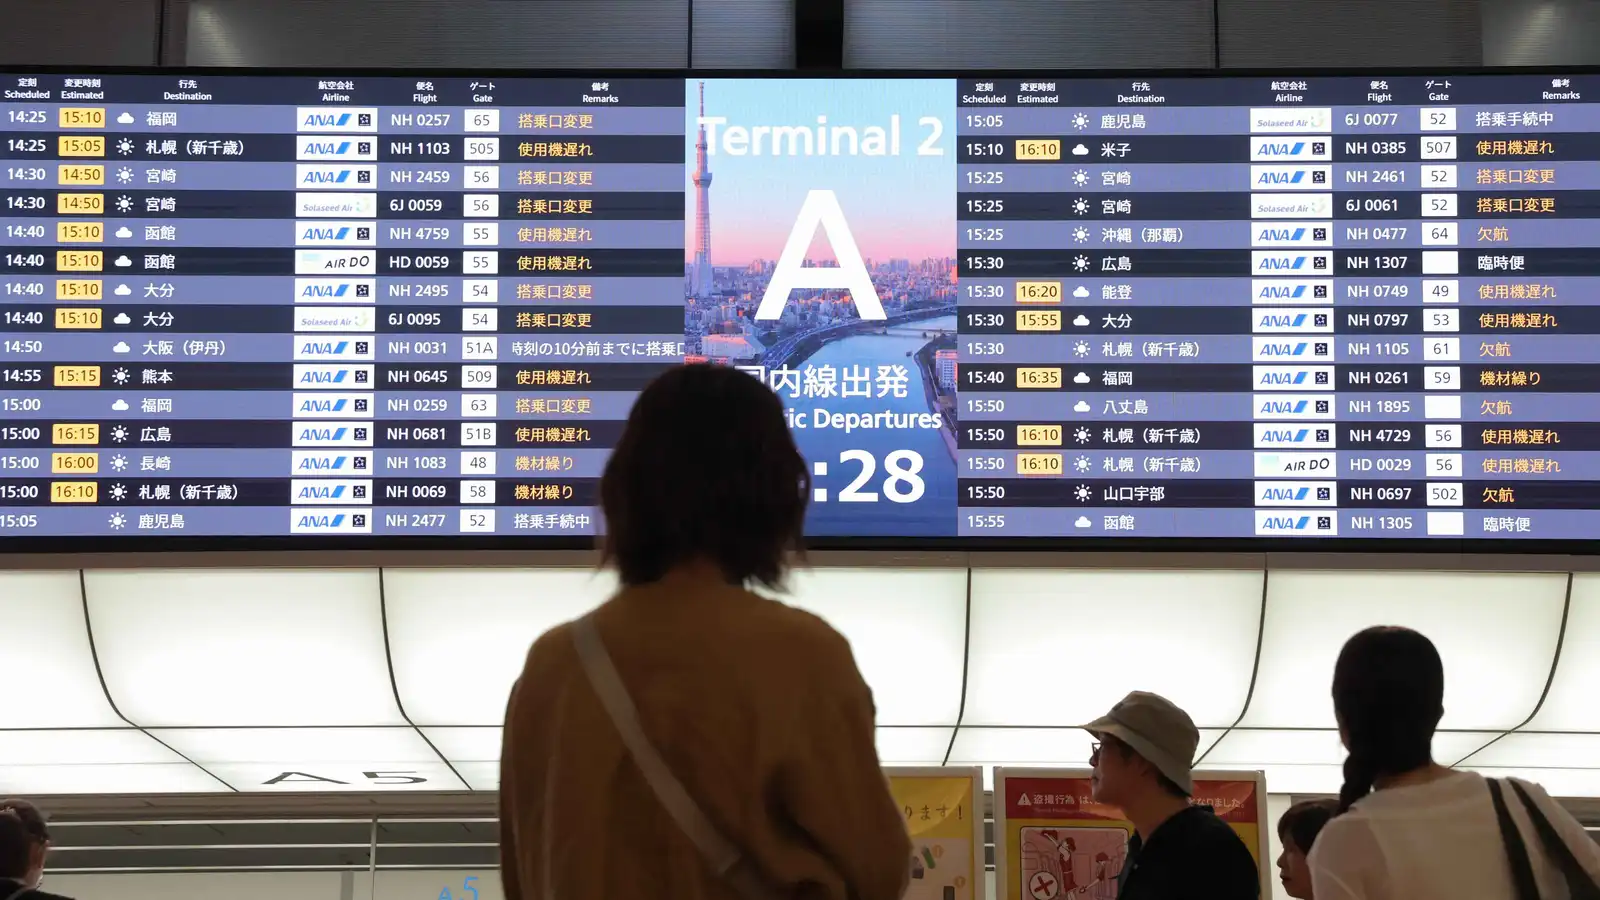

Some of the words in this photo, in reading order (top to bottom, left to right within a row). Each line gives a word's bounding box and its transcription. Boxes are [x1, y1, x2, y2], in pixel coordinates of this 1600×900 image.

[17, 77, 37, 88] 定刻
[64, 78, 101, 88] 変更時刻
[179, 80, 197, 88] 行先
[319, 81, 354, 90] 航空会社
[416, 82, 433, 90] 便名
[470, 82, 495, 90] ゲート
[592, 82, 609, 92] 備考
[976, 82, 993, 91] 定刻
[1020, 82, 1056, 92] 変更時刻
[1132, 82, 1150, 91] 行先
[1271, 81, 1307, 90] 航空会社
[1370, 81, 1388, 89] 便名
[1426, 80, 1451, 89] ゲート
[1552, 79, 1569, 87] 備考
[5, 90, 50, 98] Scheduled
[61, 91, 103, 99] Estimated
[164, 92, 212, 100] Destination
[322, 93, 349, 101] Airline
[414, 94, 437, 103] Flight
[473, 94, 492, 102] Gate
[963, 95, 1006, 103] Scheduled
[1018, 95, 1058, 103] Estimated
[1368, 93, 1391, 103] Flight
[1543, 91, 1580, 99] Remarks
[9, 111, 46, 122] 14:25
[65, 112, 101, 123] 15:10
[146, 112, 177, 126] 福岡
[304, 115, 334, 126] ANA
[392, 114, 412, 125] NH
[417, 114, 450, 126] 0257
[474, 115, 489, 126] 65
[518, 114, 592, 128] 搭乗口変更
[697, 115, 899, 156] Terminal
[918, 117, 944, 156] 2
[8, 140, 46, 151] 14:25
[64, 140, 100, 151] 15:05
[146, 140, 243, 155] 札幌（新千歳）
[304, 143, 334, 154] ANA
[391, 143, 411, 154] NH
[418, 143, 449, 154] 1103
[471, 143, 493, 154] 505
[518, 143, 593, 156] 使用機遅れ
[967, 144, 1003, 155] 15:10
[1021, 144, 1056, 155] 16:10
[1101, 143, 1131, 157] 米子
[1258, 144, 1288, 155] ANA
[1346, 142, 1367, 154] NH
[1372, 142, 1406, 154] 0385
[1427, 142, 1450, 153] 507
[1476, 140, 1554, 155] 使用機遅れ
[7, 197, 45, 208] 14:30
[64, 198, 100, 208] 14:50
[146, 197, 176, 211] 宮崎
[390, 199, 403, 211] 6J
[408, 199, 442, 211] 0059
[474, 200, 489, 211] 56
[518, 199, 592, 213] 搭乗口変更
[967, 229, 1003, 240] 15:25
[1102, 228, 1184, 242] 沖縄（那覇）
[1259, 230, 1289, 240] ANA
[1347, 228, 1368, 239] NH
[1373, 228, 1406, 239] 0477
[1432, 228, 1448, 239] 64
[1478, 227, 1508, 241] 欠航
[6, 254, 44, 266] 14:40
[754, 189, 887, 320] A
[63, 255, 98, 266] 15:10
[145, 253, 175, 272] 函館
[325, 259, 345, 268] AIR
[350, 256, 369, 267] DO
[390, 256, 411, 268] HD
[415, 256, 449, 268] 0059
[474, 257, 488, 268] 55
[517, 256, 592, 270] 使用機遅れ
[967, 286, 1003, 297] 15:30
[1021, 286, 1057, 297] 16:20
[1102, 285, 1132, 299] 能登
[1259, 287, 1290, 298] ANA
[1348, 286, 1368, 297] NH
[1374, 285, 1408, 297] 0749
[1432, 286, 1448, 296] 49
[1478, 285, 1556, 299] 使用機遅れ
[4, 341, 42, 352] 14:50
[143, 340, 225, 355] 大阪（伊丹）
[301, 343, 331, 354] ANA
[389, 342, 409, 353] NH
[414, 342, 446, 353] 0031
[467, 342, 493, 353] 51A
[3, 370, 41, 381] 14:55
[60, 370, 96, 381] 15:15
[142, 369, 172, 383] 熊本
[301, 372, 331, 382] ANA
[388, 371, 409, 382] NH
[414, 371, 447, 382] 0645
[468, 371, 491, 382] 509
[516, 370, 591, 384] 使用機遅れ
[968, 372, 1004, 383] 15:40
[1022, 372, 1057, 383] 16:35
[1103, 371, 1132, 385] 福岡
[1260, 373, 1291, 384] ANA
[1349, 372, 1370, 383] NH
[1375, 372, 1407, 383] 0261
[1435, 372, 1450, 383] 59
[1480, 371, 1540, 386] 機材繰り
[813, 408, 942, 433] Departures
[2, 428, 40, 439] 15:00
[58, 428, 94, 439] 16:15
[141, 427, 171, 441] 広島
[300, 429, 330, 440] ANA
[388, 428, 408, 440] NH
[413, 428, 445, 440] 0681
[467, 428, 490, 439] 51B
[515, 428, 590, 441] 使用機遅れ
[968, 458, 1004, 469] 15:50
[1022, 458, 1058, 469] 16:10
[1103, 457, 1200, 472] 札幌（新千歳）
[1284, 461, 1305, 471] AIR
[1310, 458, 1329, 470] DO
[1351, 459, 1372, 470] HD
[1377, 459, 1411, 470] 0029
[1437, 459, 1452, 470] 56
[1482, 459, 1560, 473] 使用機遅れ
[814, 449, 925, 503] :28
[968, 487, 1004, 498] 15:50
[1105, 486, 1164, 501] 山口宇部
[1262, 489, 1293, 500] ANA
[1351, 488, 1372, 499] NH
[1377, 488, 1411, 499] 0697
[1433, 488, 1456, 500] 502
[1483, 488, 1514, 502] 欠航
[0, 515, 37, 527] 15:05
[138, 514, 184, 528] 鹿児島
[298, 516, 328, 527] ANA
[386, 515, 407, 526] NH
[412, 515, 445, 526] 2477
[471, 515, 485, 526] 52
[514, 514, 589, 528] 搭乗手続中
